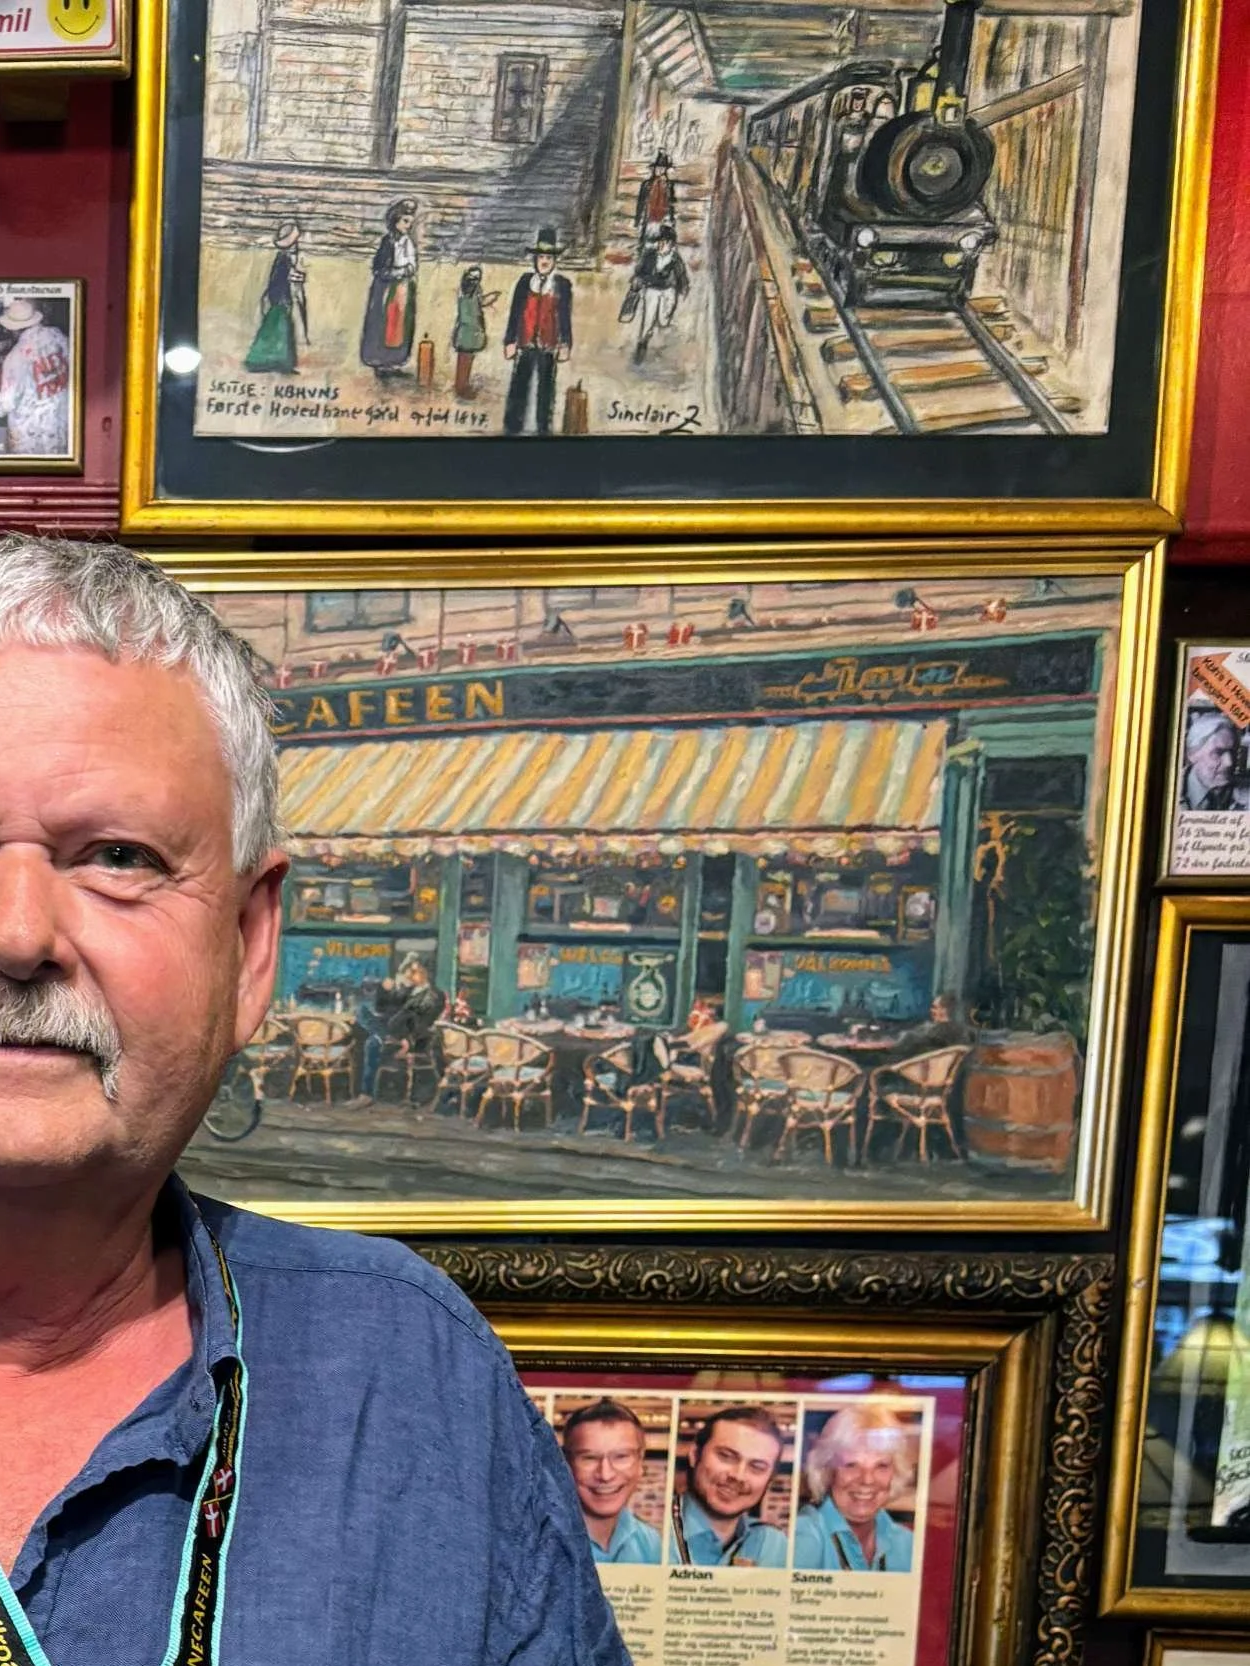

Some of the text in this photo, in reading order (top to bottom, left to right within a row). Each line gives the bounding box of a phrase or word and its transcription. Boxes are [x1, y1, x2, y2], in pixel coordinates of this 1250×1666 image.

[206, 399, 263, 417] Første
[669, 1568, 714, 1580] Adrian
[791, 1571, 833, 1584] Sanne
